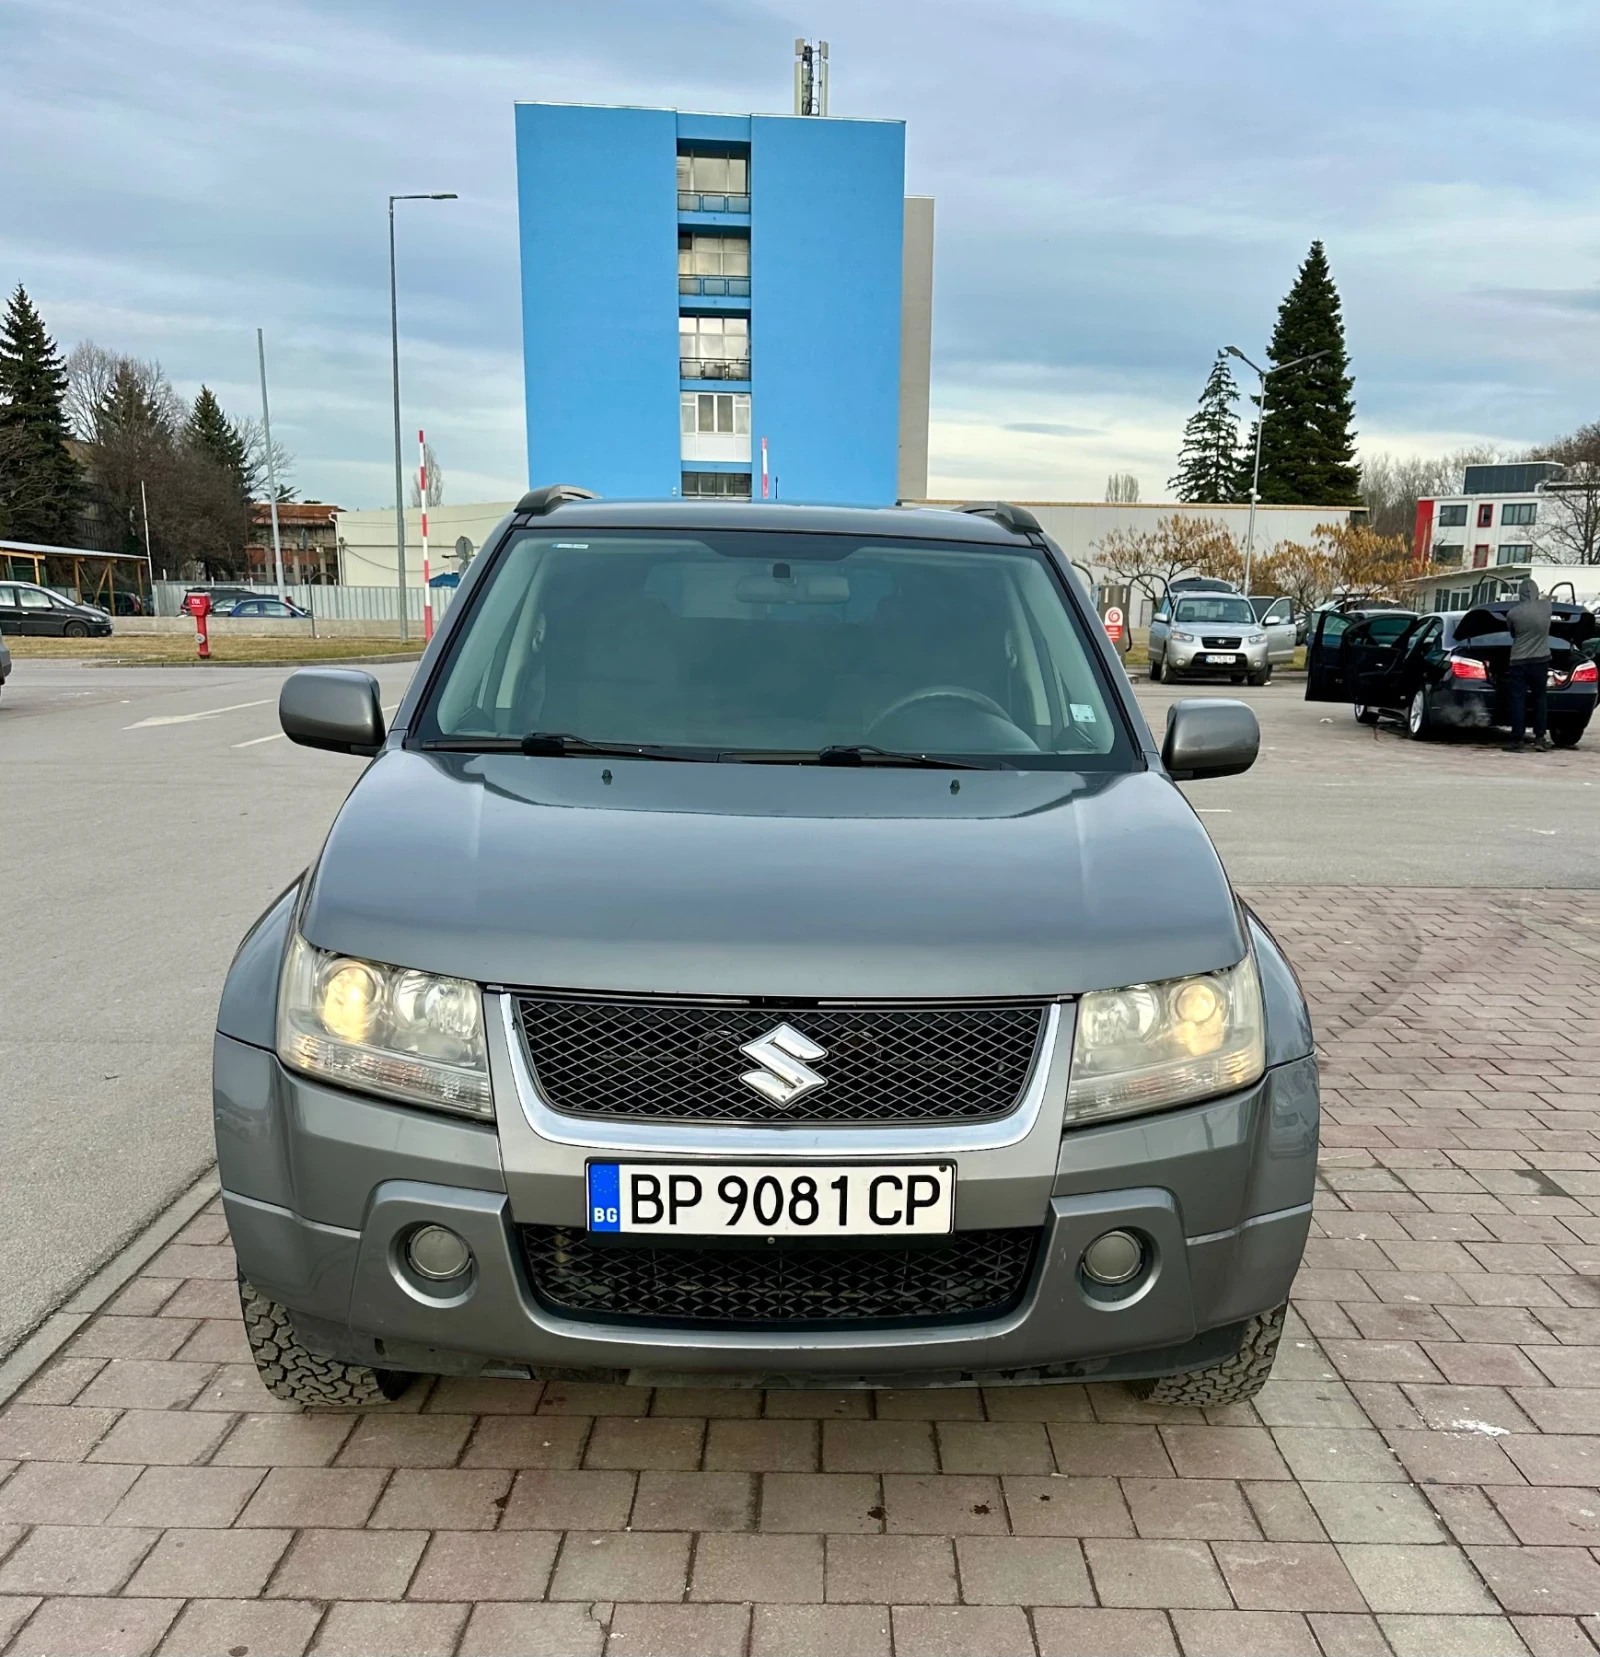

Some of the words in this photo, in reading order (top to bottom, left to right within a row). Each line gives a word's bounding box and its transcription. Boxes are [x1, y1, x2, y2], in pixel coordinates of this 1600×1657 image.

[594, 1207, 618, 1223] BG
[631, 1174, 702, 1226] BP
[717, 1175, 848, 1226] 9081
[868, 1175, 941, 1226] CP
